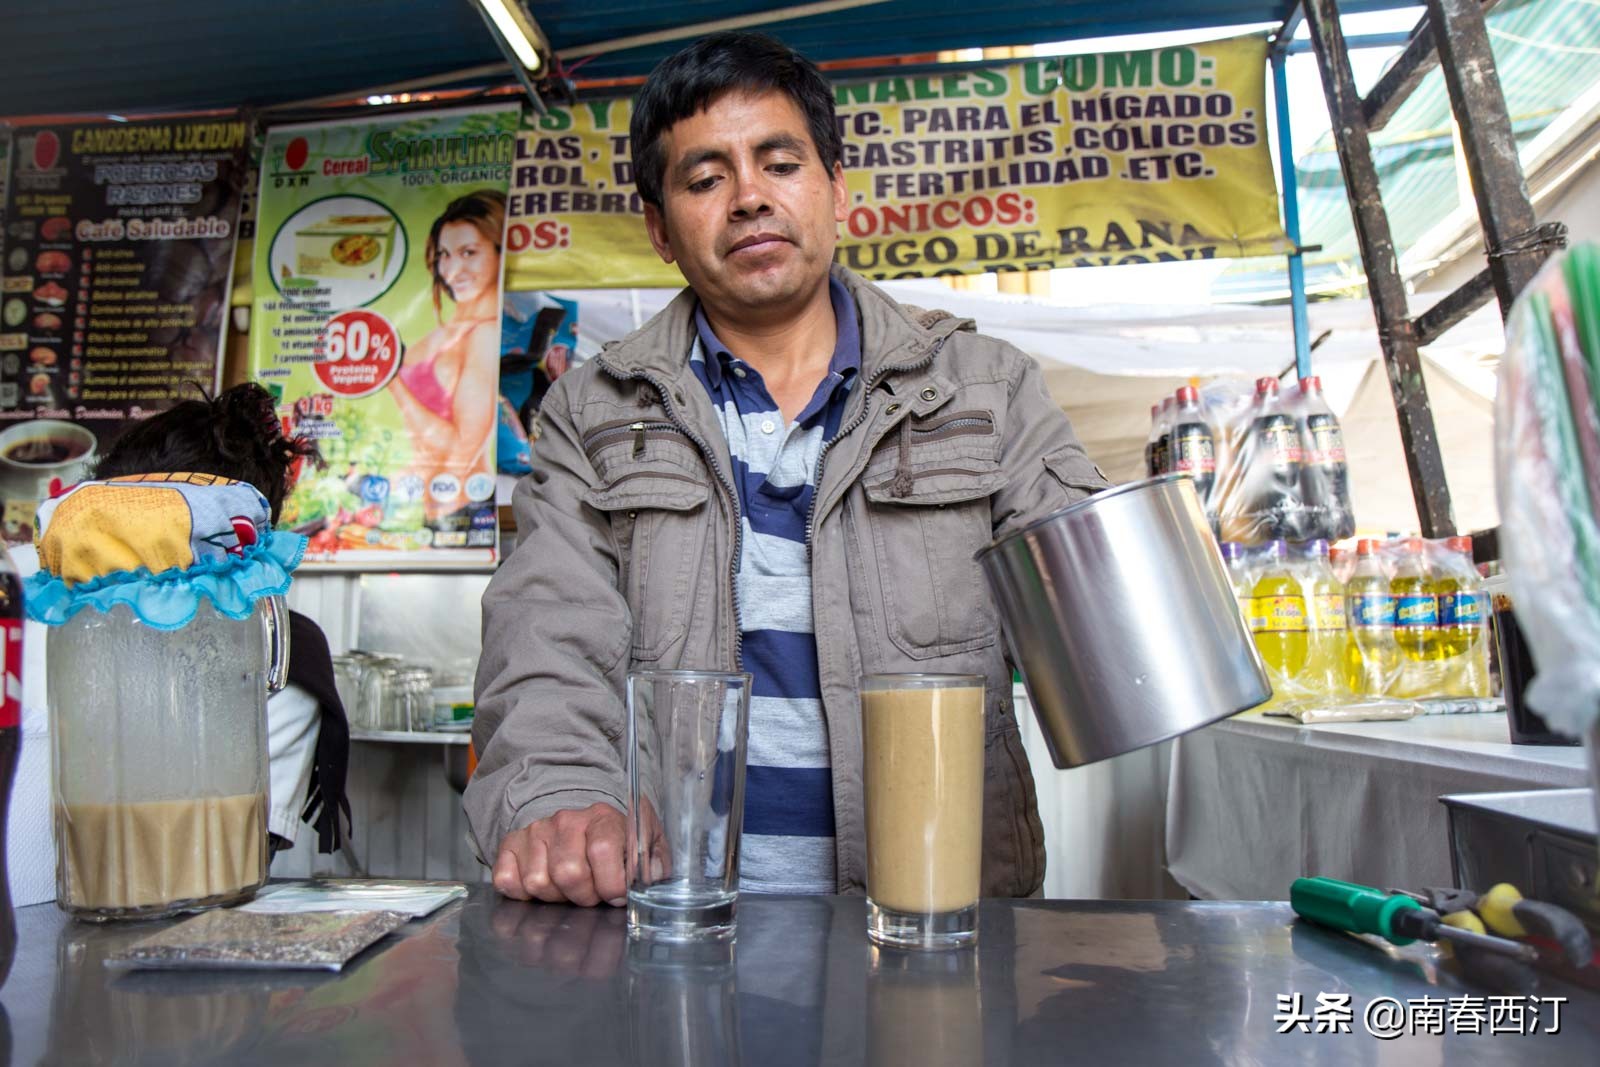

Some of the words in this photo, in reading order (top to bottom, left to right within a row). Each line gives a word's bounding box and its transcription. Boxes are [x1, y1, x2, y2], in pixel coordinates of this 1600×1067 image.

[1024, 46, 1214, 96] COMO:
[904, 105, 1010, 133] PARA
[1021, 100, 1061, 127] EL
[174, 122, 246, 149] LUCIDUM
[841, 130, 1053, 168] GASTRITIS
[95, 162, 217, 184] PODEROSAS
[323, 156, 369, 176] Cereal
[401, 172, 435, 186] 100%
[875, 157, 1109, 198] FERTILIDAD
[107, 184, 202, 205] RAZONES
[76, 219, 125, 240] Café
[127, 216, 230, 239] Saludable
[507, 221, 569, 252] OS:
[973, 230, 1044, 266] DE
[1057, 219, 1209, 255] RANA
[325, 320, 391, 362] 60%
[313, 394, 334, 416] kg
[432, 482, 457, 493] FDA
